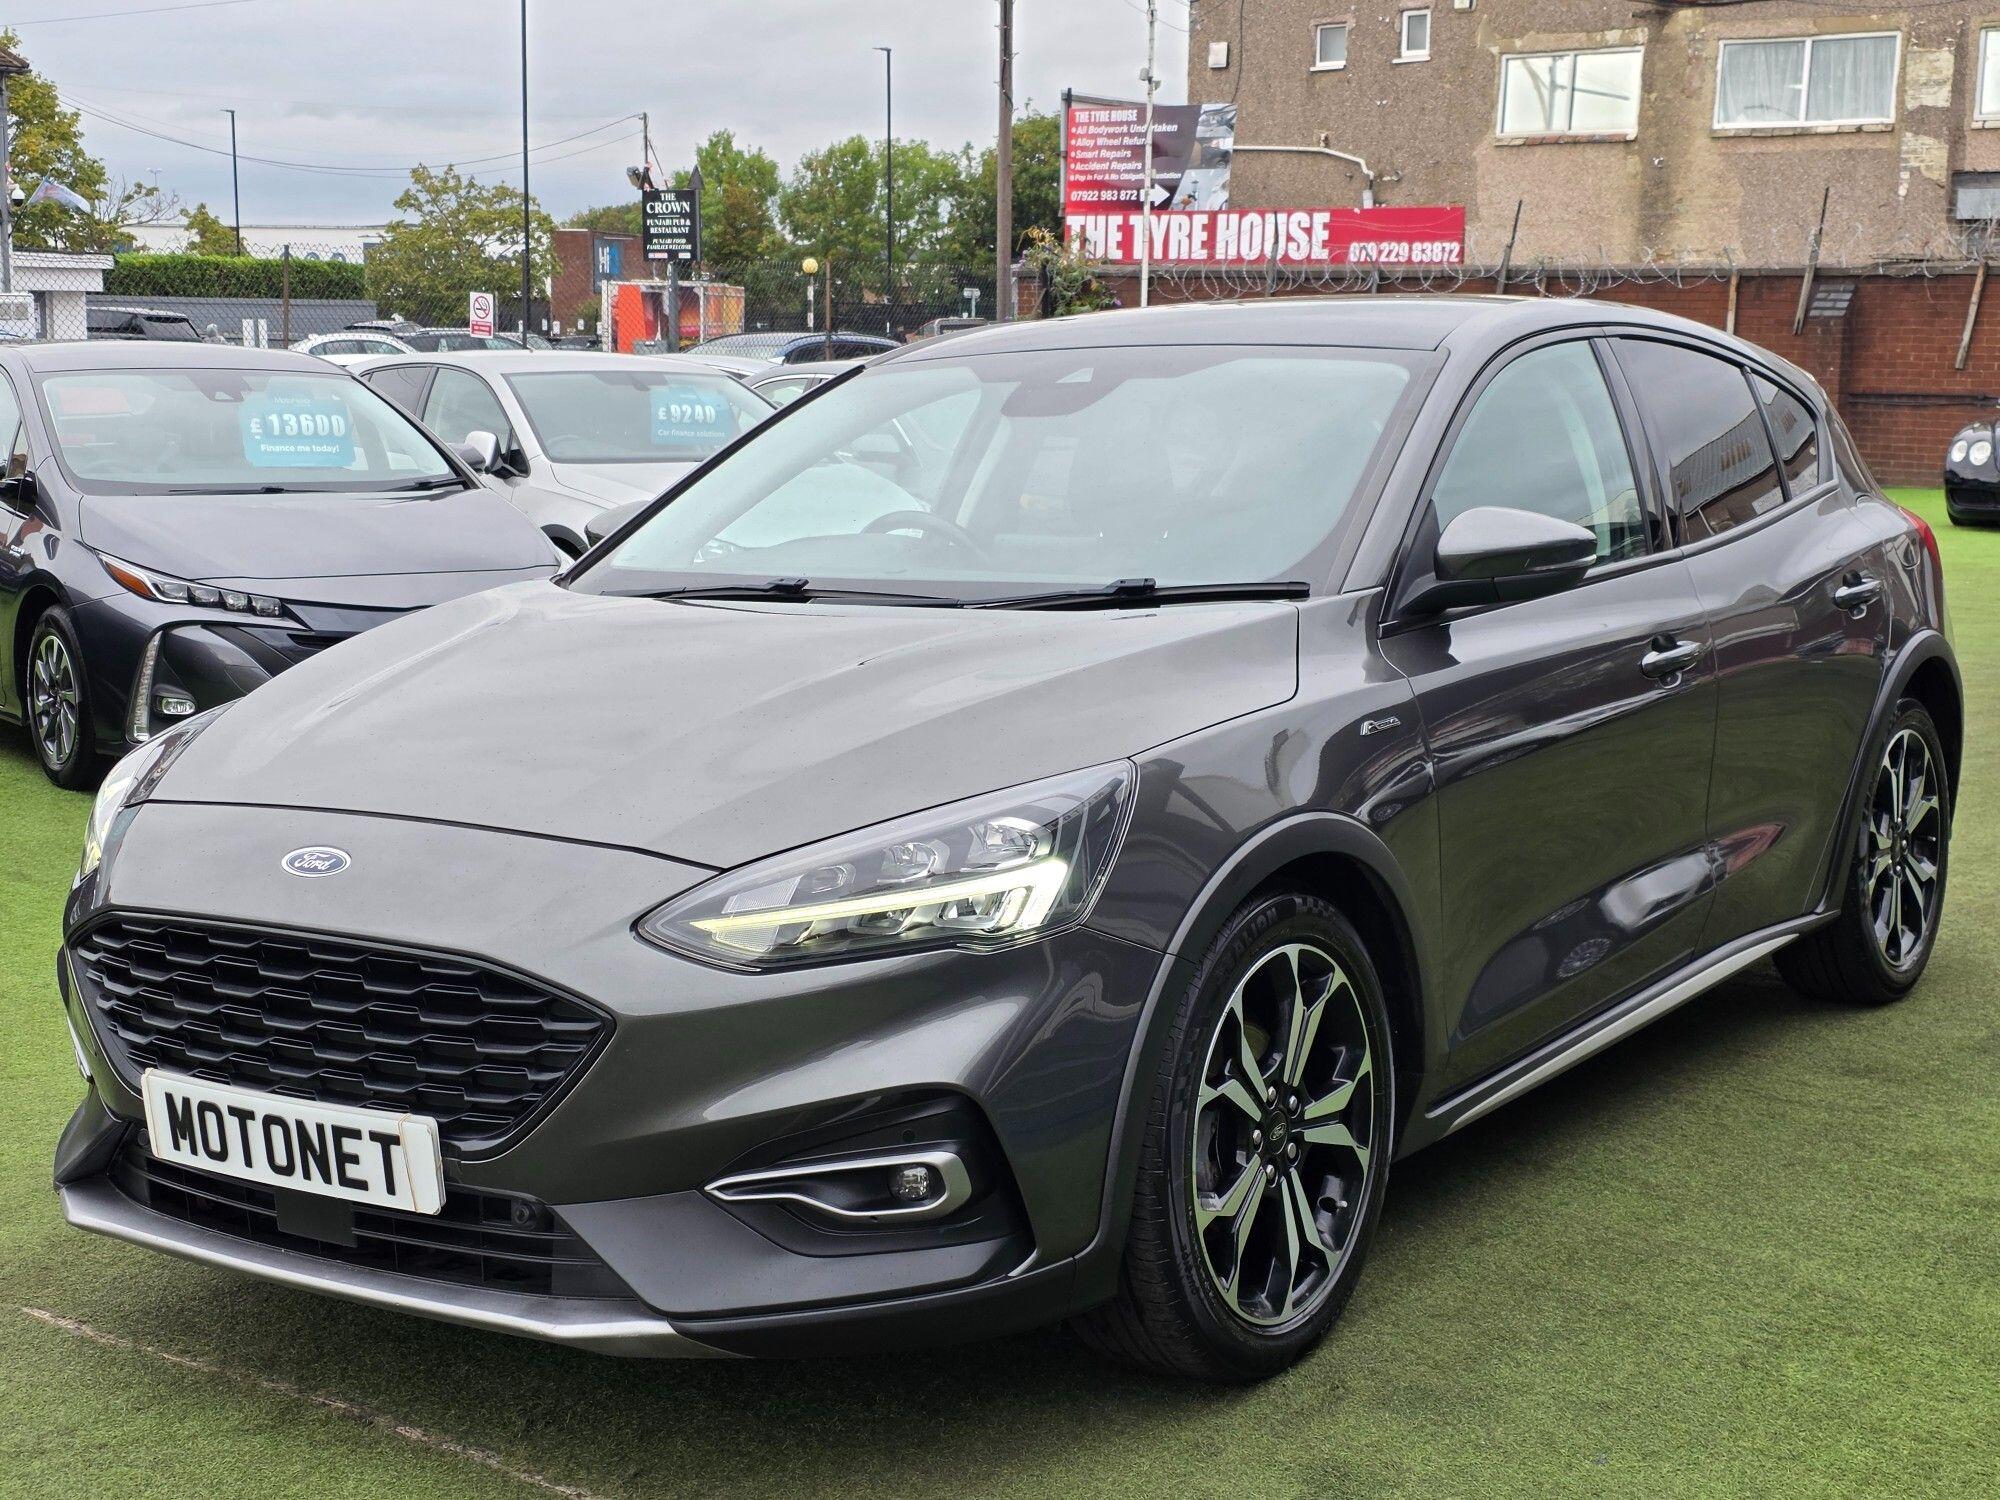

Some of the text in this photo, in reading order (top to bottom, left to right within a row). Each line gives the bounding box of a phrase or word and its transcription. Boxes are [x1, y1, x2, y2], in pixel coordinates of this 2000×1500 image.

[1075, 110, 1137, 123] THE TYRE HOUSE
[1076, 122, 1178, 135] All Bodywork Undrtaken
[1076, 137, 1095, 148] Alloy
[1096, 136, 1121, 146] Wheel
[1076, 149, 1132, 160] Smart Repairs
[1075, 160, 1142, 172] Accident Repairs
[660, 193, 677, 201] THE
[1071, 190, 1137, 201] 07922 983 872
[646, 201, 691, 214] CROWN
[650, 226, 690, 234] RESTAURANT
[1066, 212, 1331, 261] THE TYRE HOUSE
[1379, 241, 1410, 262] 229
[670, 404, 716, 424] 9240
[268, 412, 346, 437] 13600
[260, 443, 340, 454] Finance me today!
[294, 852, 337, 870] Ford
[164, 1091, 402, 1196] MOTONET
